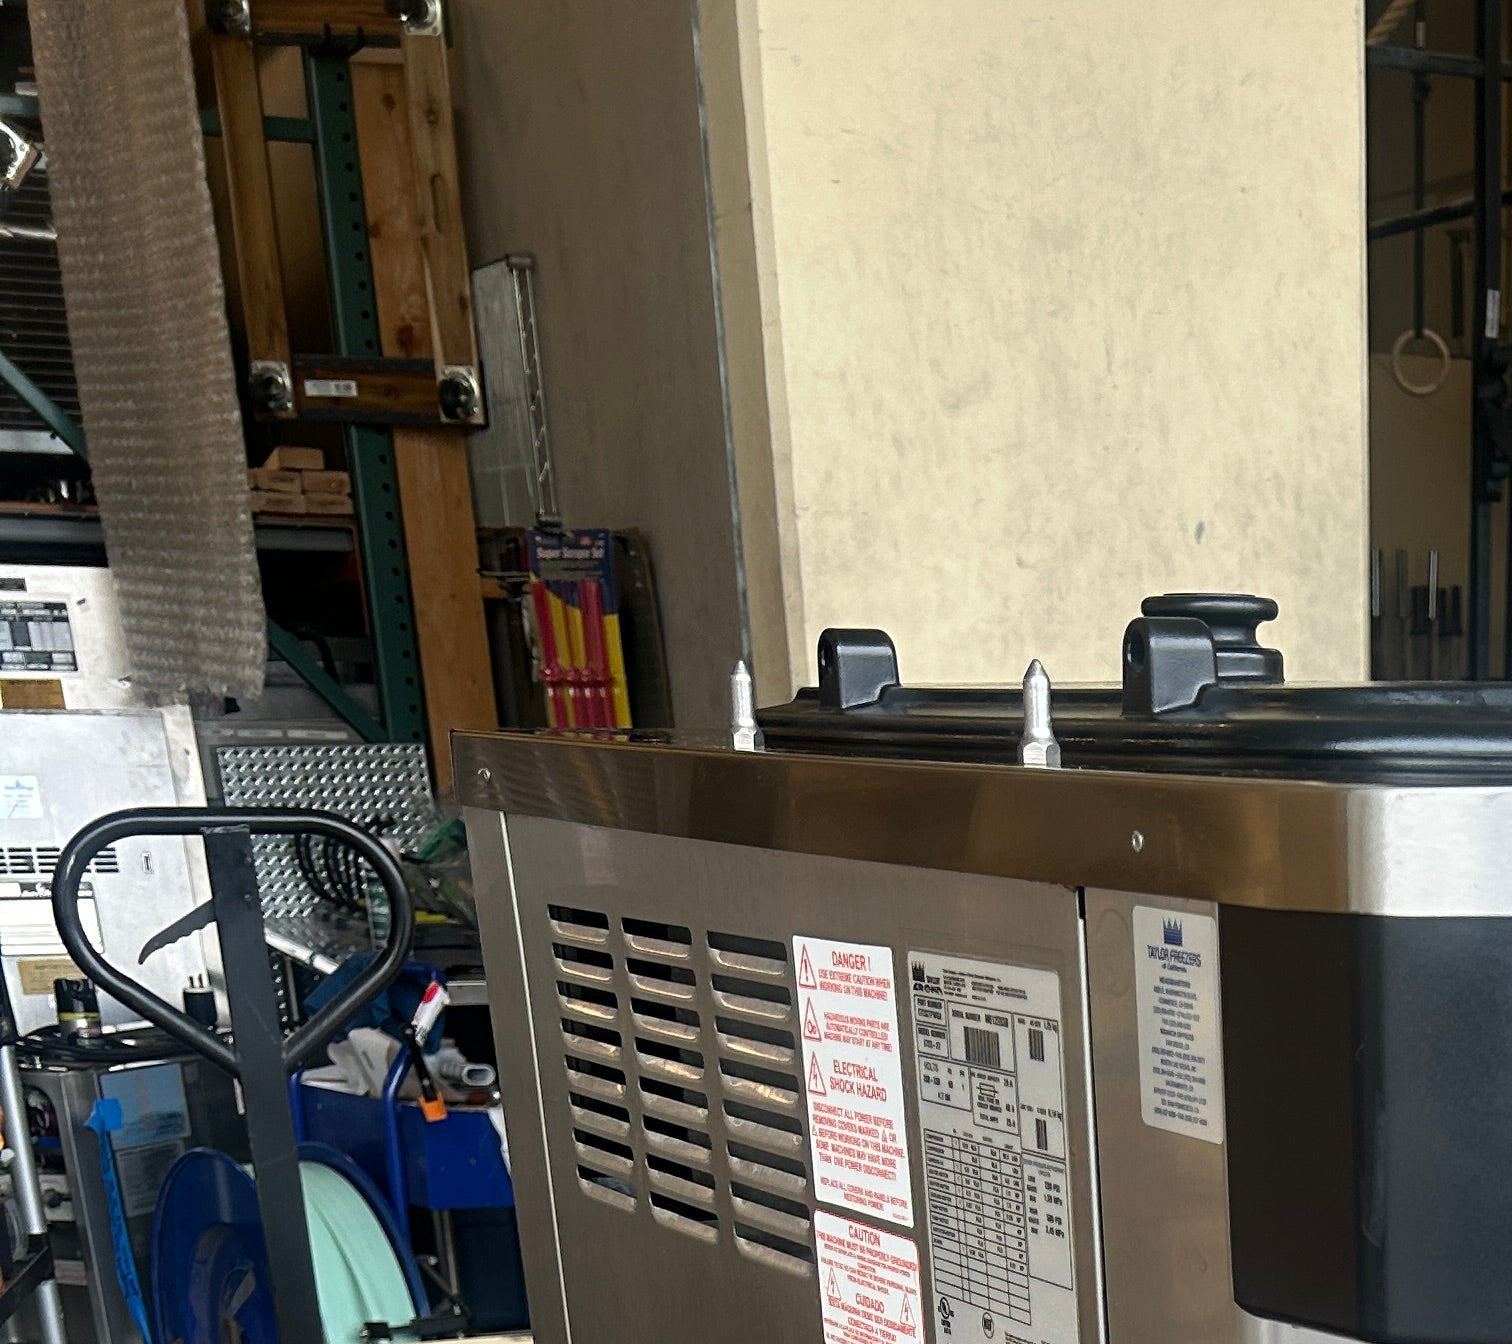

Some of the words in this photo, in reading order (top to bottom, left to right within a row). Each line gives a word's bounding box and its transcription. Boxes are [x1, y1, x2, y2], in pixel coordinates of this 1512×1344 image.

[832, 950, 866, 970] DANGER
[833, 1060, 878, 1082] ELECTRICAL
[829, 1076, 854, 1095] SHOCK
[856, 1082, 886, 1102] HAZARD
[848, 1224, 881, 1246] CAUTION
